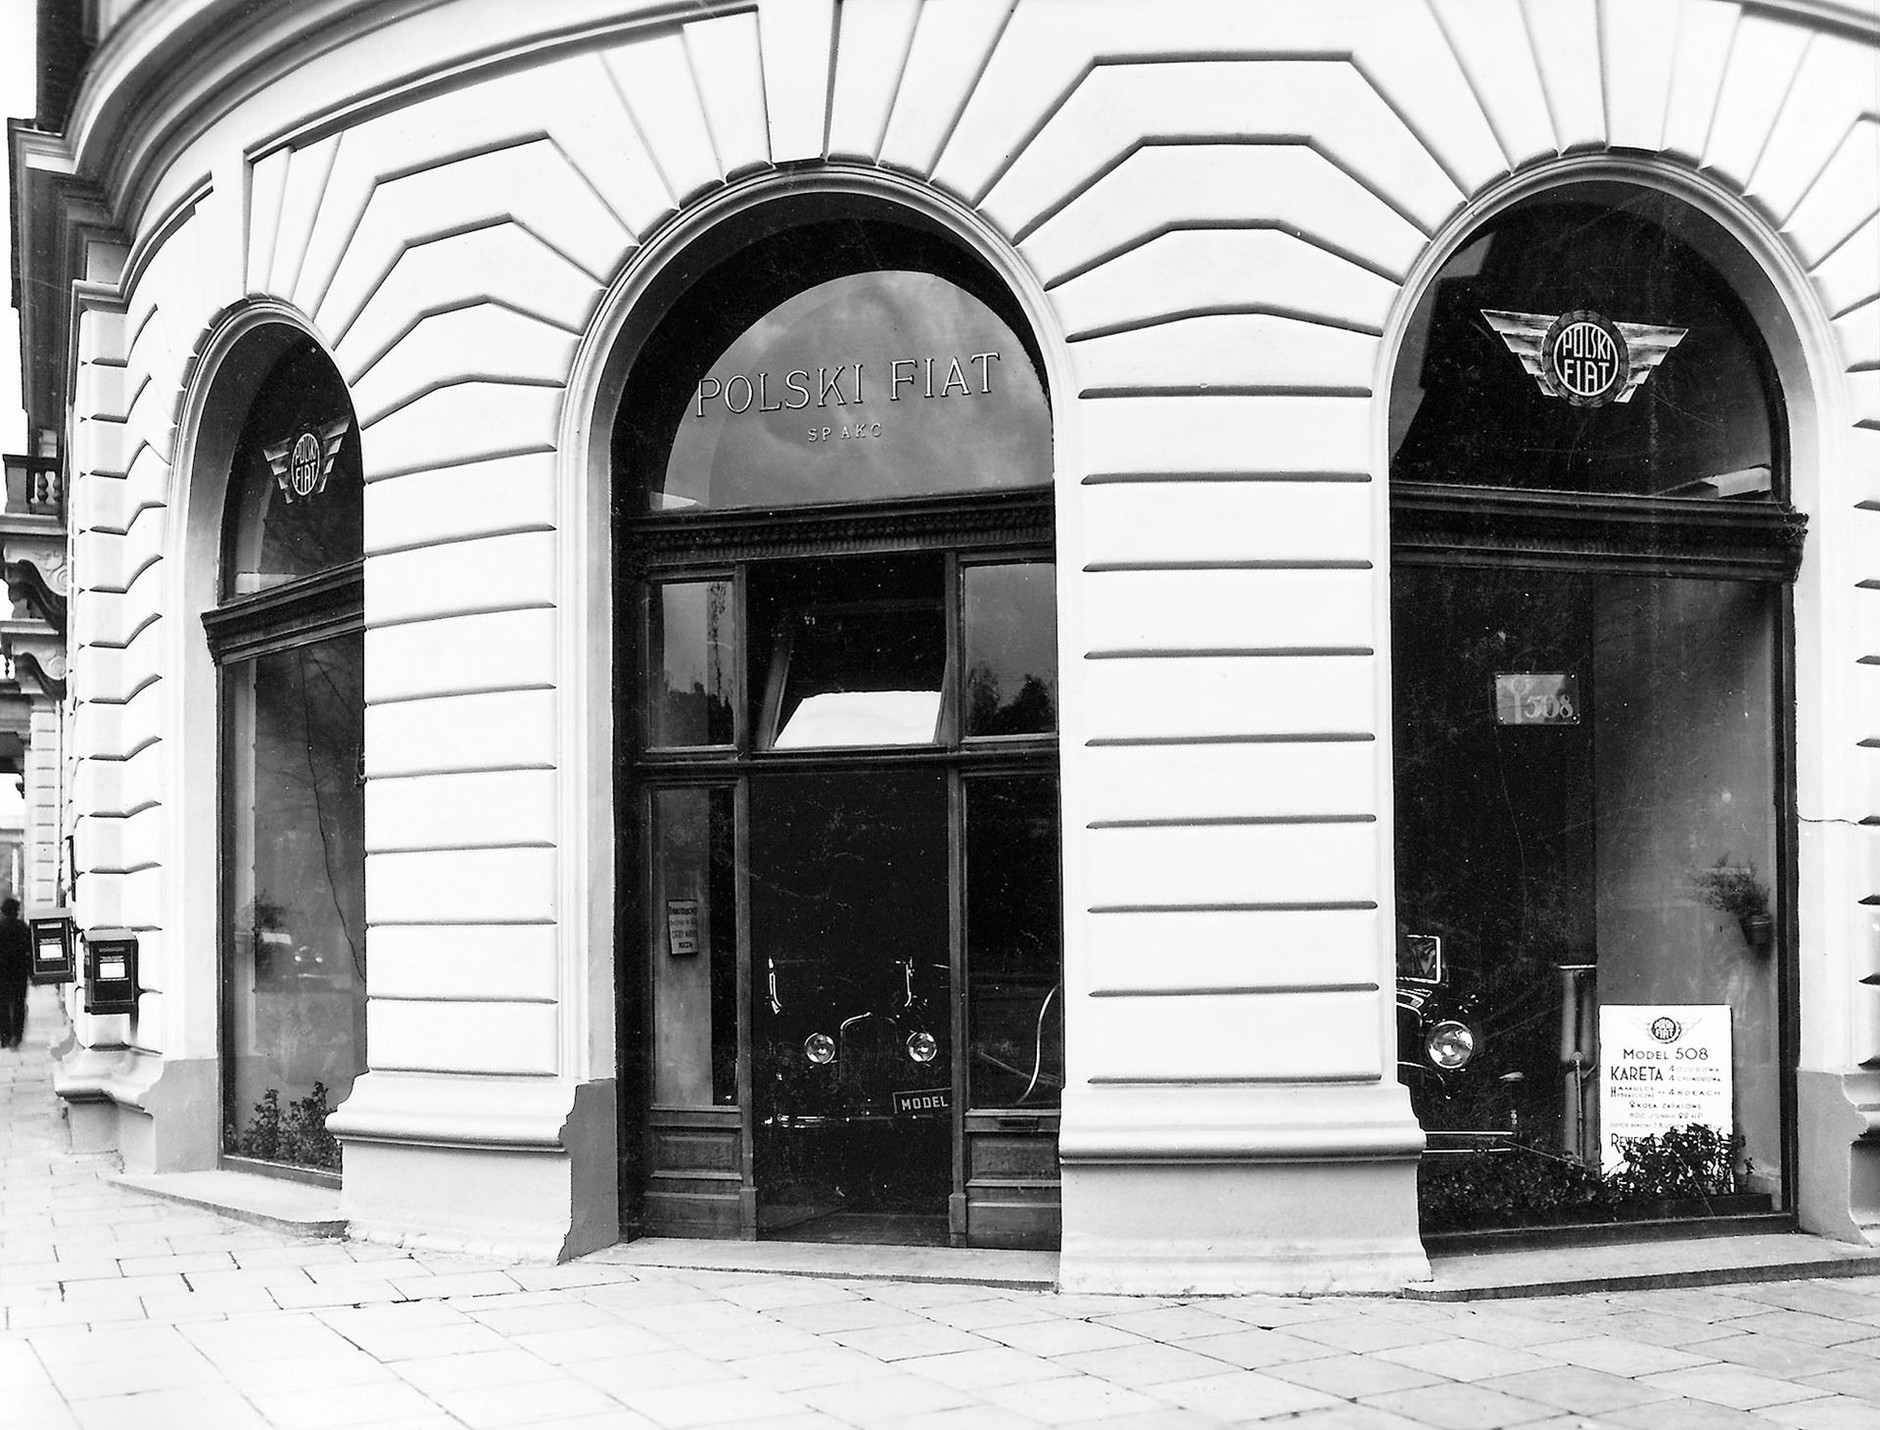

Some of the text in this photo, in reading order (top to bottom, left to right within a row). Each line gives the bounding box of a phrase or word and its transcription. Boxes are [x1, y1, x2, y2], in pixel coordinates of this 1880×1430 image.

[1562, 326, 1611, 360] POLSKI
[696, 352, 1000, 417] POLSKI FIAT
[1563, 359, 1610, 393] FIAT
[295, 461, 317, 492] FIAT
[1623, 1047, 1709, 1061] MODEL 508
[1610, 1066, 1664, 1081] KARETA
[901, 1095, 949, 1111] MODEL
